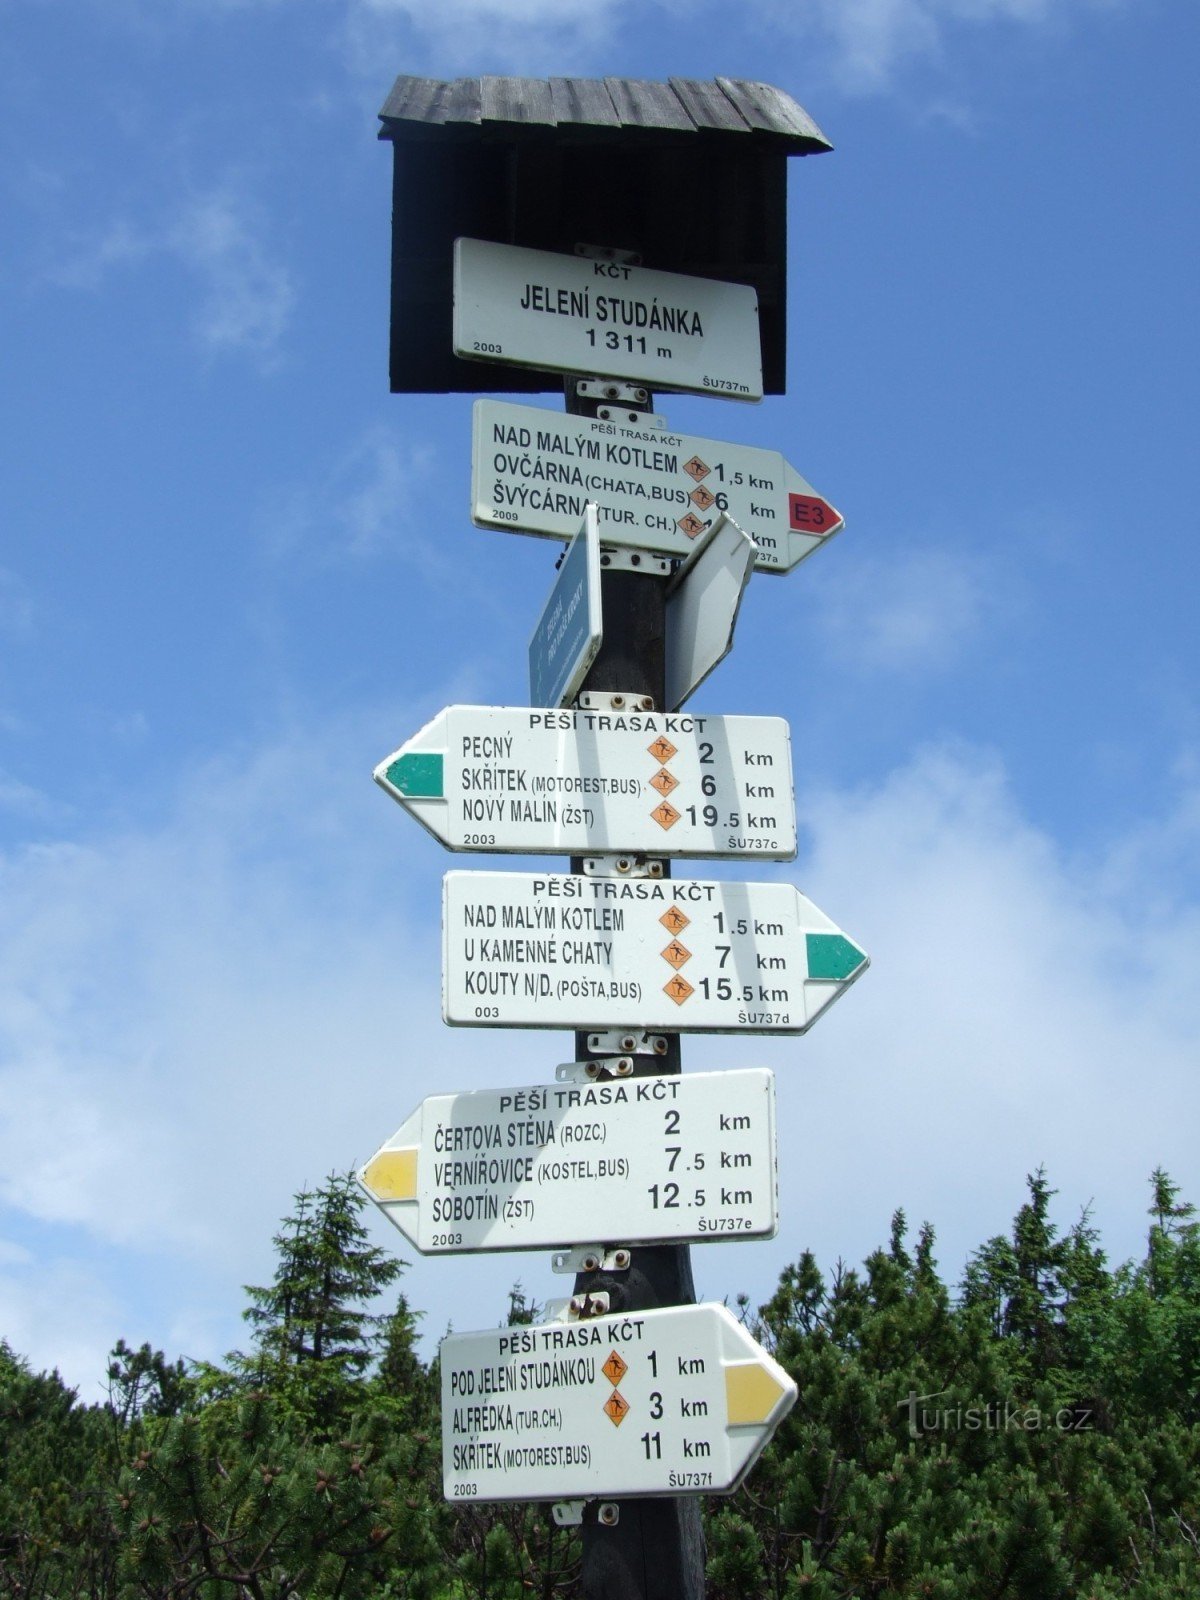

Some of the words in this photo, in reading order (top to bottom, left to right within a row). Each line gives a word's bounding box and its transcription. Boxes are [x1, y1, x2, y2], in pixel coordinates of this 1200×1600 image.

[594, 262, 631, 280] KČT
[520, 284, 589, 319] JELENÍ
[596, 298, 704, 337] STUDÁNKA
[473, 341, 502, 354] 2003
[657, 347, 672, 359] m
[703, 376, 750, 393] ŠU737m
[590, 423, 617, 436] PĚŠÍ
[620, 429, 657, 443] TRASA
[660, 434, 683, 447] KČT
[493, 424, 531, 448] NAD
[537, 432, 600, 461] MALÝM
[606, 443, 678, 474] KOTLEM
[749, 474, 774, 491] km
[492, 509, 519, 521] 2009
[715, 492, 729, 511] 6
[751, 502, 776, 519] km
[794, 503, 825, 525] E3
[529, 711, 577, 730] PĚŠÍ
[584, 715, 657, 732] TRASA
[462, 731, 513, 758] PECNÝ
[699, 742, 715, 764] 2
[744, 751, 773, 766] km
[462, 762, 527, 791] SKŘÍTEK
[701, 774, 717, 797] 6
[746, 783, 775, 798] km
[463, 793, 505, 822] NOVÝ
[510, 794, 557, 823] MALÍN
[561, 804, 594, 828] (ŽST)
[747, 813, 777, 829] km
[463, 834, 496, 845] 2003
[728, 835, 778, 849] ŠU737c
[533, 877, 582, 898] PĚŠÍ
[590, 883, 665, 900] TRASA
[673, 882, 715, 902] KČT
[464, 904, 497, 928] NAD
[502, 899, 556, 930] MALÝM
[561, 907, 624, 931] KOTLEM
[754, 919, 784, 936] km
[464, 938, 474, 962] U
[480, 933, 557, 964] KAMENNÉ
[562, 940, 613, 965] CHATY
[715, 946, 731, 969] 7
[757, 953, 786, 970] km
[465, 971, 519, 996] KOUTY
[759, 986, 789, 1002] km
[738, 1010, 790, 1024] ŠU737d
[500, 1089, 547, 1113] PĚŠÍ
[554, 1086, 628, 1109] TRASA
[636, 1079, 681, 1102] KČT
[434, 1123, 502, 1153] ČERTOVA
[507, 1114, 555, 1147] STĚNA
[664, 1110, 681, 1135] 2
[719, 1114, 751, 1131] km
[434, 1153, 533, 1187] VERNÍŘOVICE
[720, 1152, 752, 1168] km
[433, 1188, 498, 1222] SOBOTÍN
[502, 1196, 534, 1223] (ŽST)
[721, 1188, 753, 1205] km
[698, 1217, 752, 1232] ŠU737e
[432, 1233, 462, 1246] 2003
[500, 1330, 536, 1355] PĚŠÍ
[542, 1327, 602, 1350] TRASA
[608, 1318, 644, 1343] KČT
[452, 1370, 474, 1397] POD
[478, 1359, 517, 1394] JELENÍ
[520, 1353, 595, 1390] STUDÁNKOU
[647, 1350, 657, 1378] 1
[678, 1356, 705, 1375] km
[453, 1399, 513, 1434] ALFRÉDKA
[649, 1391, 664, 1420] 3
[681, 1398, 708, 1417] km
[453, 1435, 502, 1471] SKŘÍTEK
[641, 1431, 661, 1460] 11
[683, 1438, 711, 1458] km
[454, 1483, 477, 1496] 2003
[668, 1470, 712, 1487] ŠU737f
